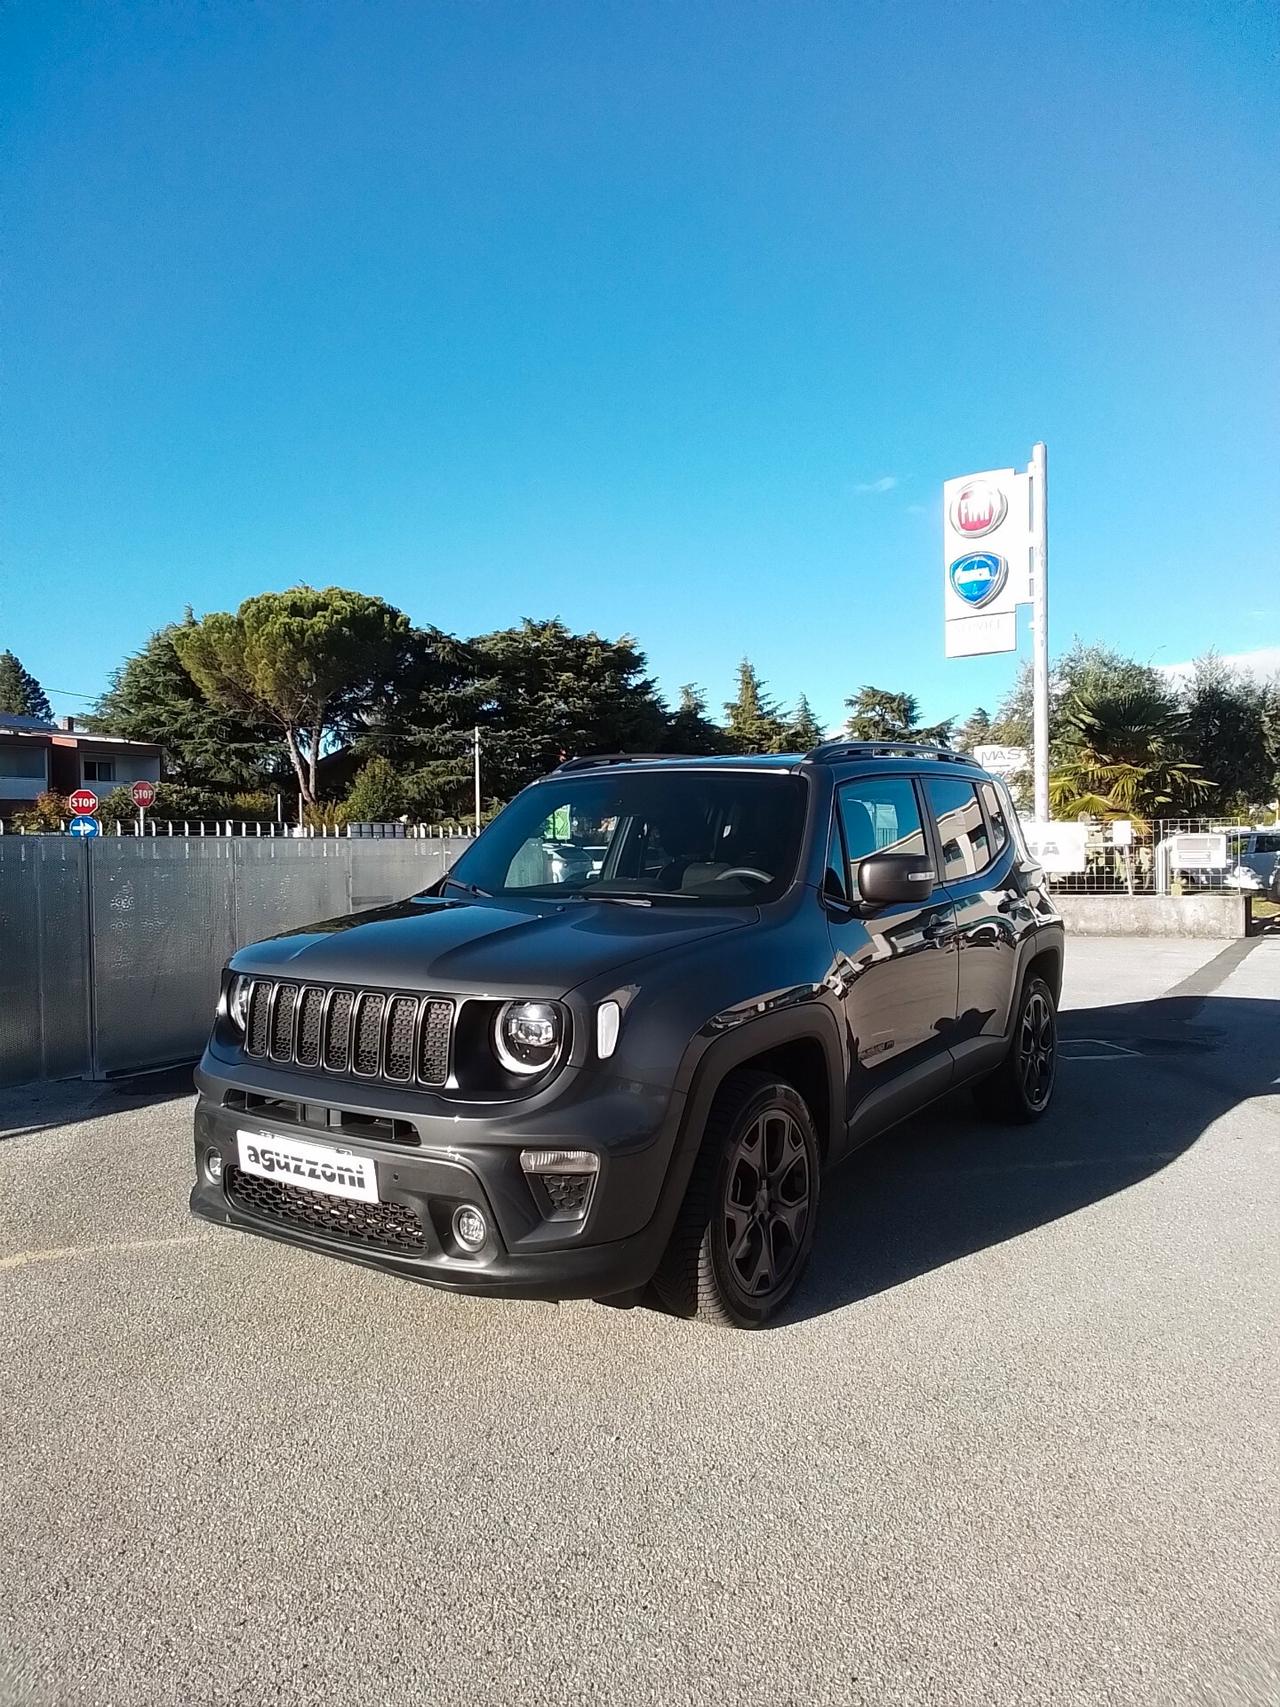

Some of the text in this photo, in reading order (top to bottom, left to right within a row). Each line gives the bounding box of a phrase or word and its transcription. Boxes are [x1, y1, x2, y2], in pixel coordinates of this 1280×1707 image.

[133, 789, 153, 800] STOP
[71, 797, 96, 808] STOP
[246, 1145, 366, 1189] aguzzoni
